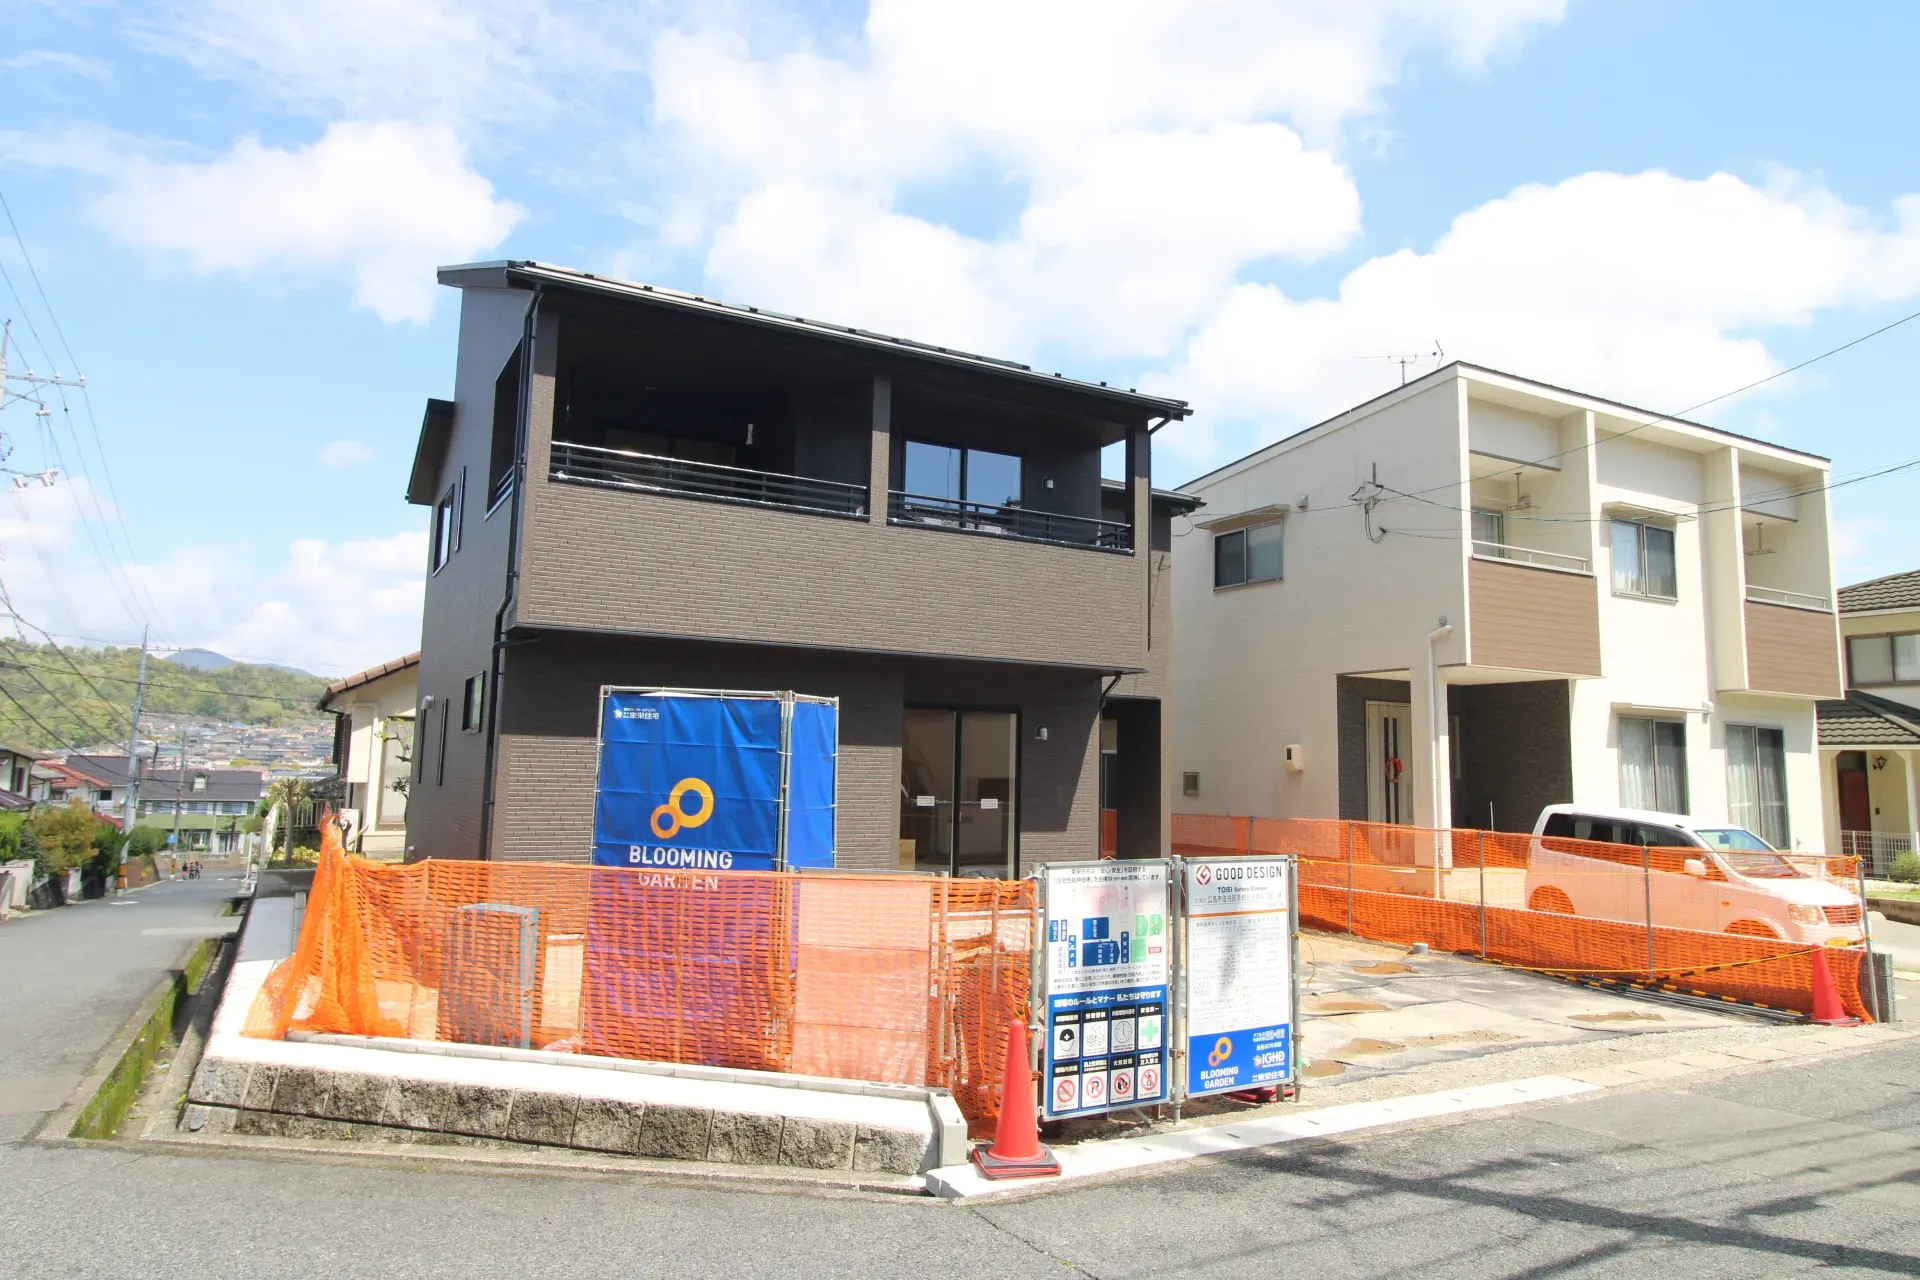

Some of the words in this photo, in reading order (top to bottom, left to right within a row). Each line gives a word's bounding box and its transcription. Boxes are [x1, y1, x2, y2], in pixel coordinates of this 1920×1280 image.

[629, 845, 733, 870] BLOOMING
[1216, 867, 1243, 880] GOOD
[1247, 866, 1282, 879] DESIGN
[1200, 1066, 1239, 1080] BLOOMING
[1204, 1076, 1235, 1089] GARDEN
